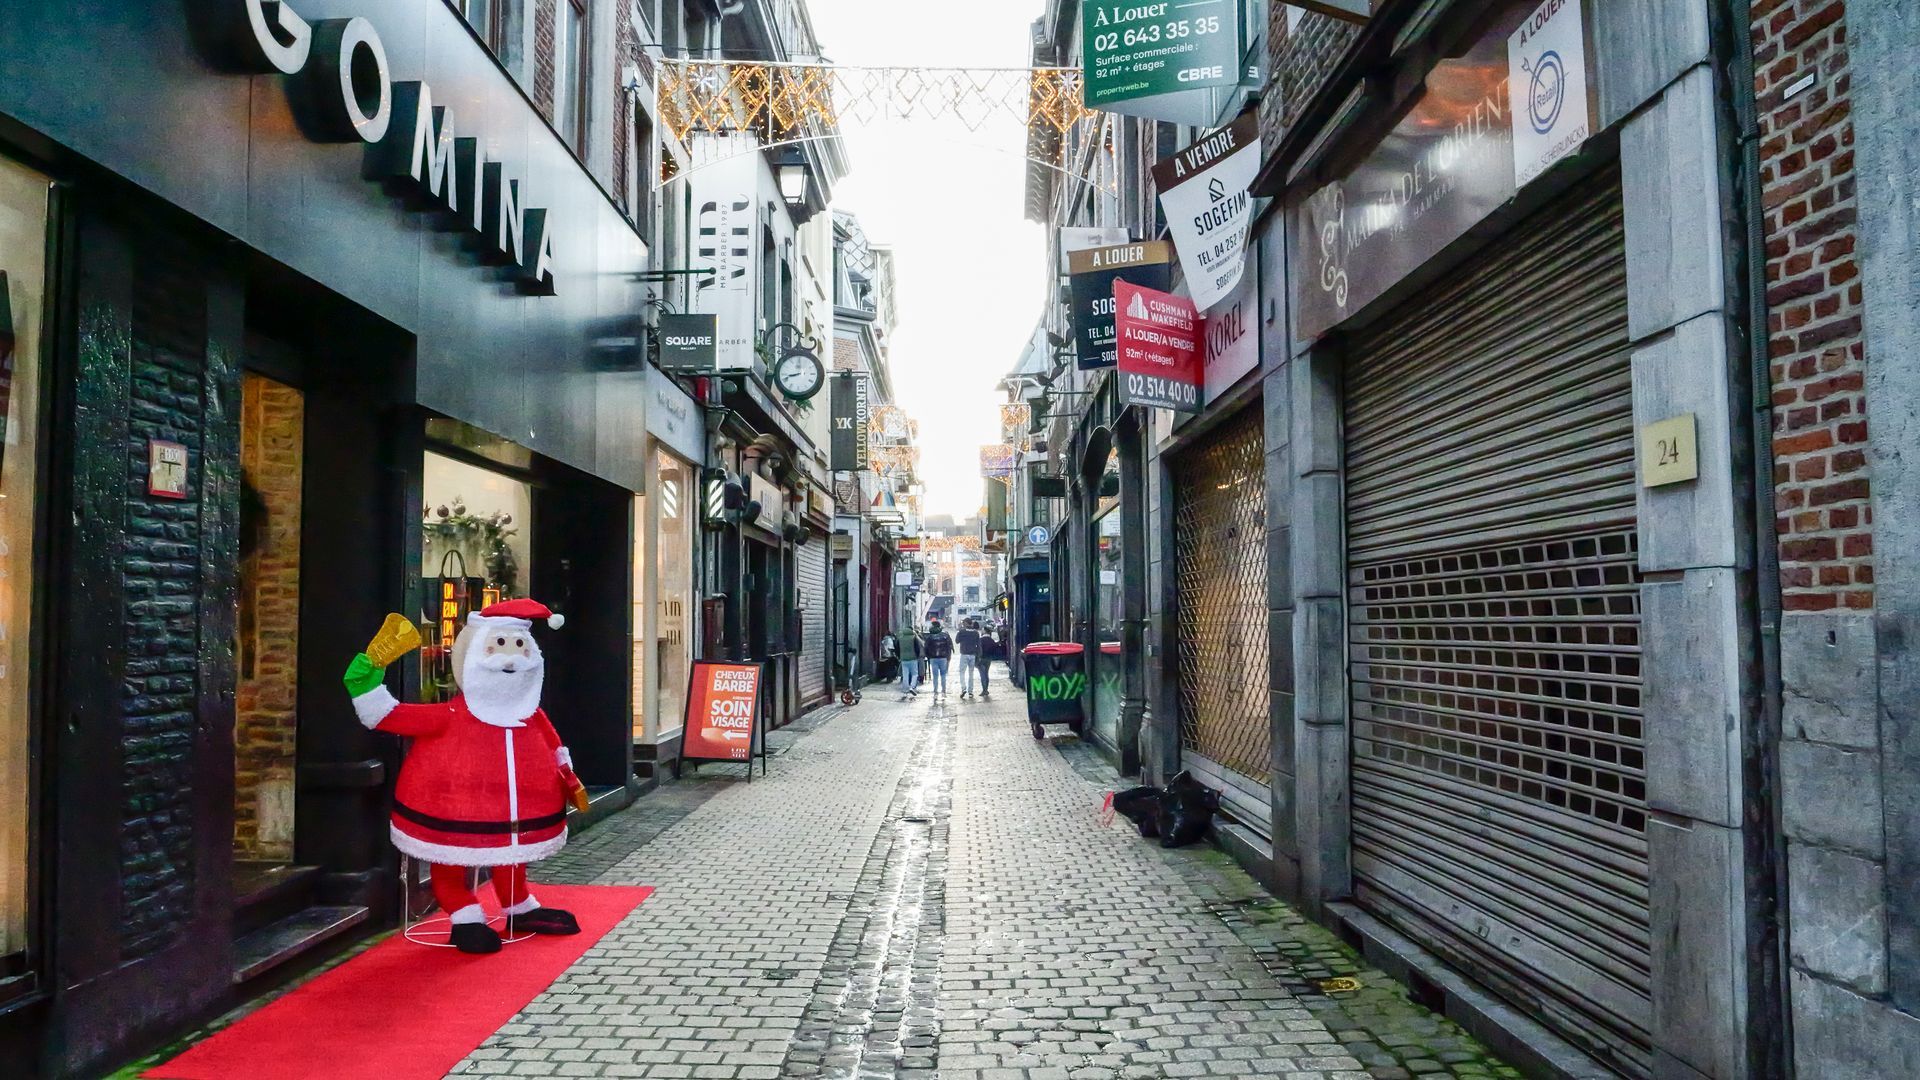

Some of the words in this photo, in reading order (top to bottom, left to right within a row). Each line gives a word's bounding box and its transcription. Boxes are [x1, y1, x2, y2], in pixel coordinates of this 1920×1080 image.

[1094, 7, 1110, 28] À
[1113, 3, 1168, 24] Louer
[1094, 32, 1119, 51] 02
[1124, 25, 1161, 47] 643
[1165, 20, 1190, 40] 35
[1195, 16, 1219, 35] 35
[1520, 30, 1527, 48] A
[1096, 54, 1131, 67] Surface
[1133, 42, 1193, 60] commerciale
[1096, 69, 1108, 79] 92
[1133, 60, 1165, 73] étages
[1177, 66, 1223, 82] CBRE
[1096, 82, 1149, 98] propertyweb.be
[1536, 84, 1557, 109] Retail
[1175, 157, 1185, 178] A
[1186, 127, 1236, 170] VENDRE
[1402, 160, 1423, 206] DE
[1194, 190, 1247, 236] SOGEFIM
[1092, 251, 1101, 267] A
[1105, 246, 1144, 265] LOUER
[1197, 252, 1214, 267] TEL.
[1214, 242, 1225, 258] 04
[1225, 234, 1237, 252] 252
[1150, 300, 1186, 318] CUSHMAN
[1188, 310, 1193, 320] &
[1088, 327, 1103, 339] TEL.
[1104, 325, 1115, 337] 04
[1150, 312, 1193, 332] WAKEFIELD
[665, 336, 712, 346] SQUARE
[1125, 328, 1131, 340] A
[1168, 335, 1195, 352] VENDRE
[1144, 351, 1175, 367] (+étages)
[1128, 374, 1144, 396] 02
[1147, 376, 1166, 399] 514
[1168, 380, 1182, 402] 40
[1183, 384, 1196, 405] 00
[835, 417, 852, 429] YK
[856, 377, 867, 468] YELLOWKORNER
[1656, 436, 1679, 467] 24
[715, 670, 755, 680] CHEVEUX
[713, 680, 754, 692] BARBE
[710, 700, 751, 716] SOIN
[710, 716, 750, 728] VISAGE
